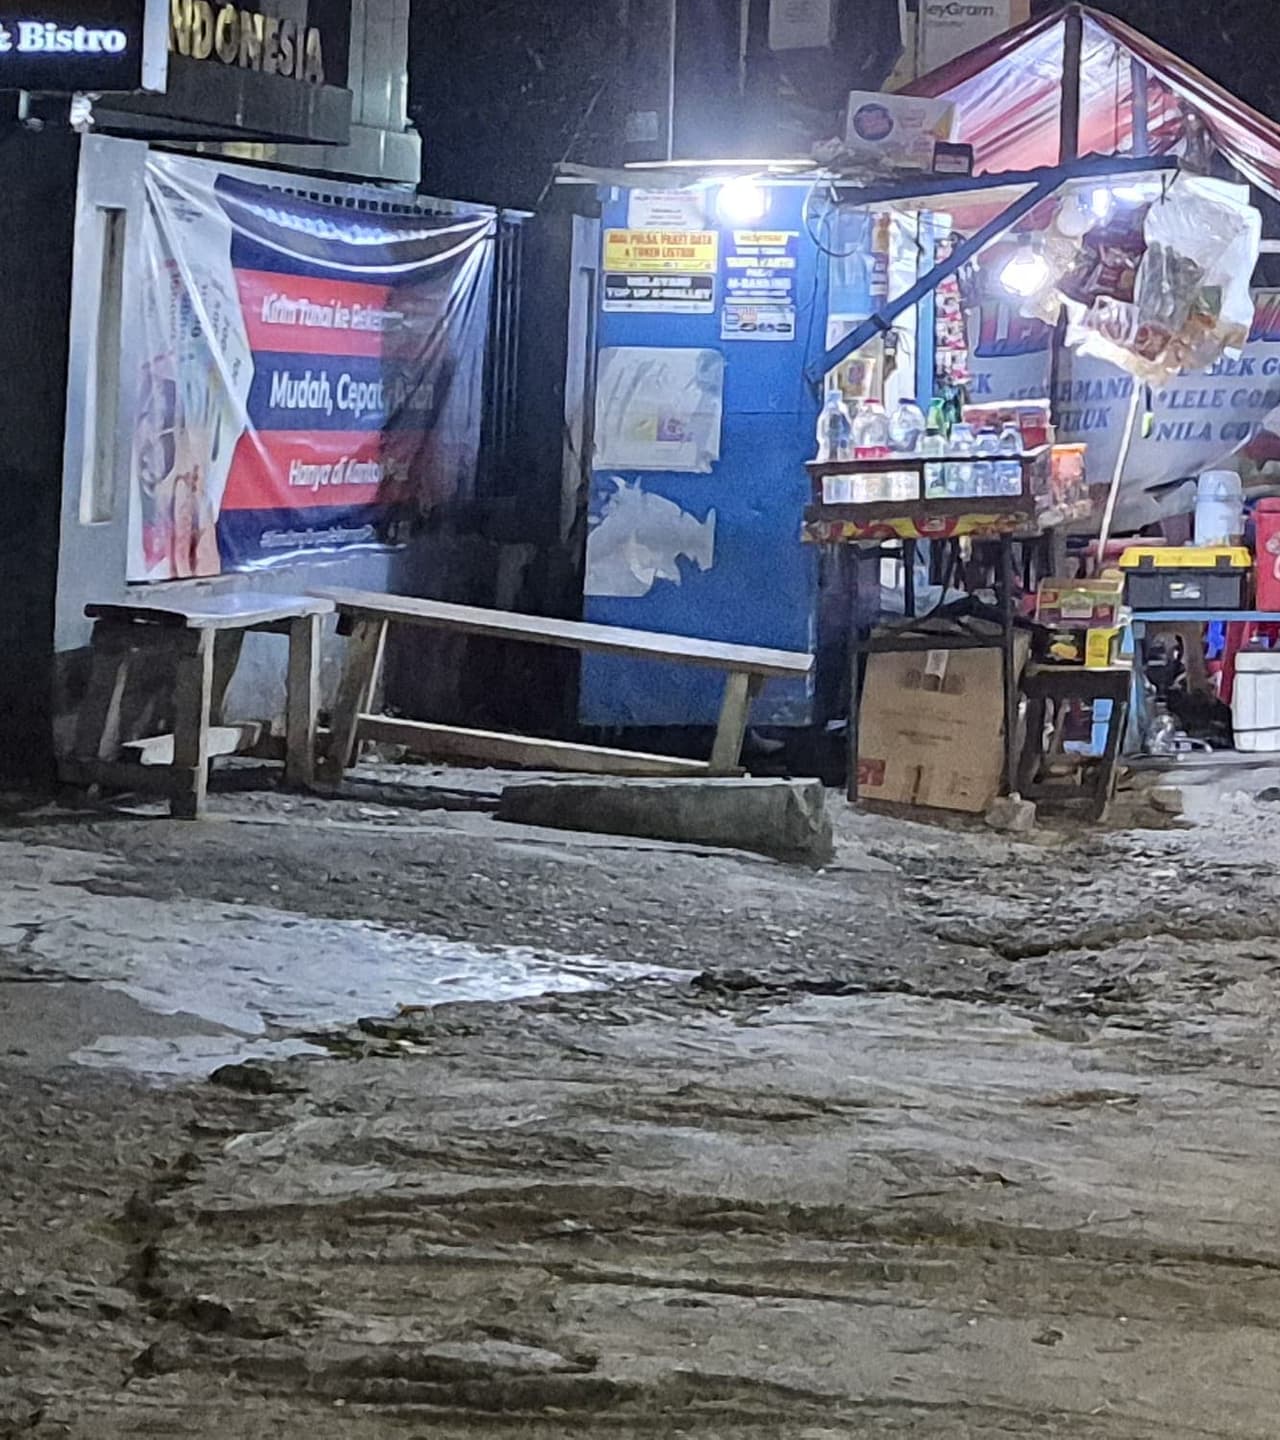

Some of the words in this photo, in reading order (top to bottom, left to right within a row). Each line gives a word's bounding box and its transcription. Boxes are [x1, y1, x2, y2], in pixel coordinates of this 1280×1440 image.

[17, 22, 127, 53] Bistro
[269, 371, 332, 417] Mudah,
[1156, 422, 1213, 441] NILA
[289, 458, 331, 492] Hanya
